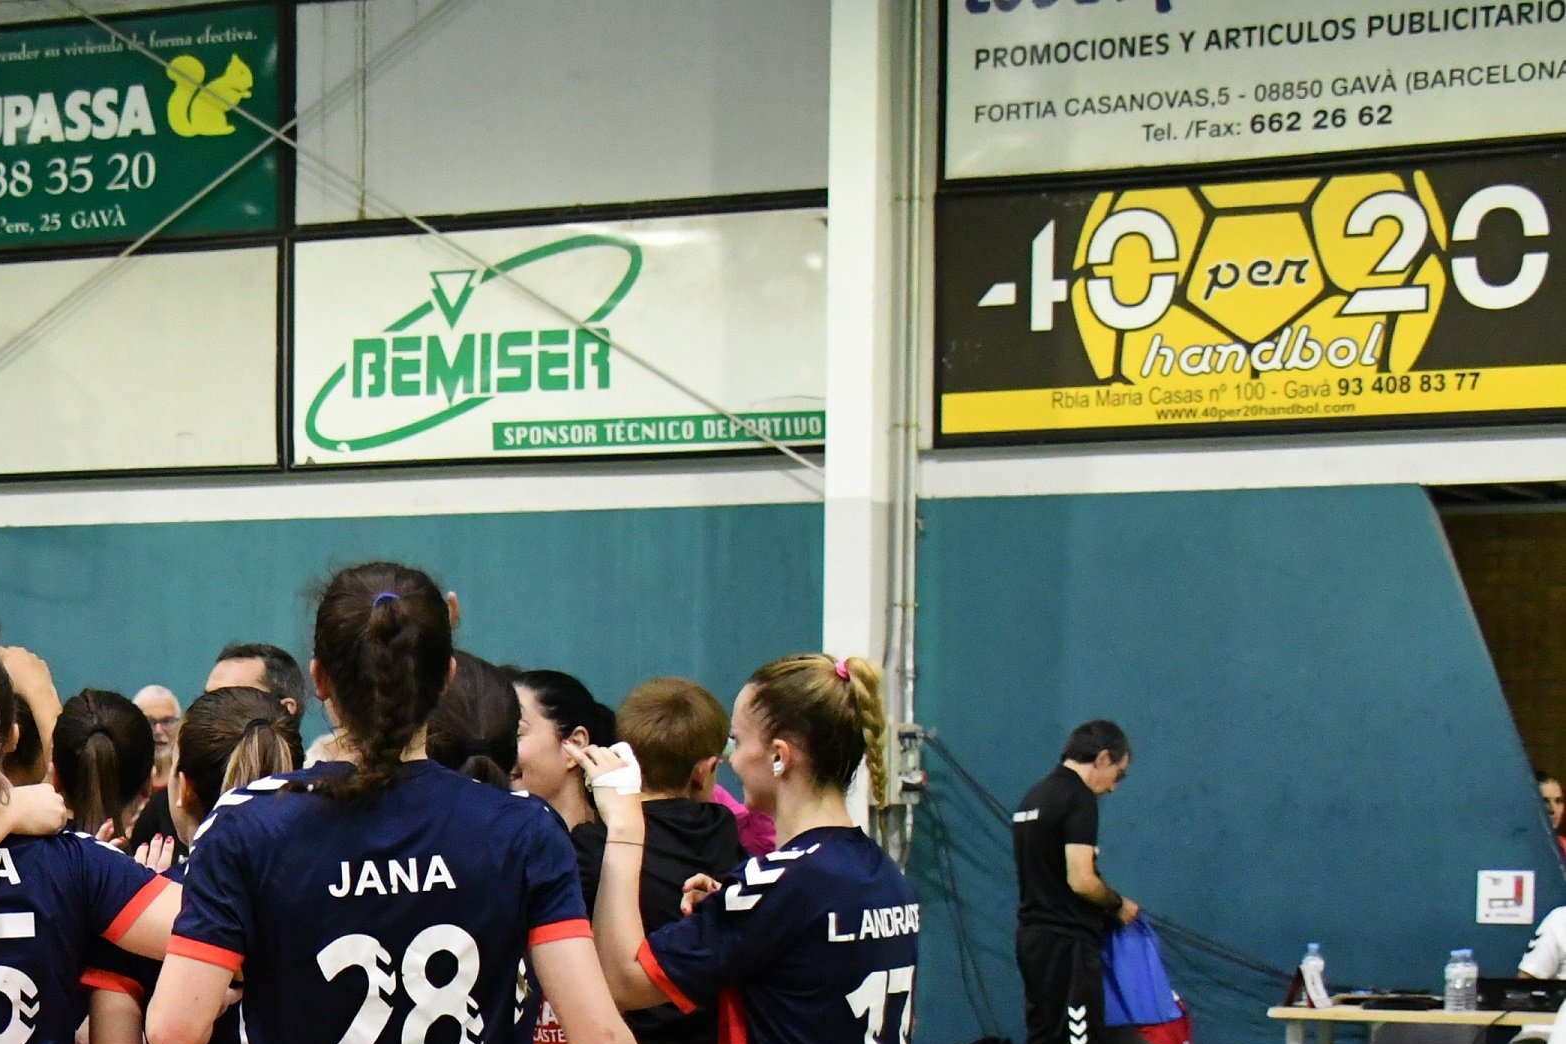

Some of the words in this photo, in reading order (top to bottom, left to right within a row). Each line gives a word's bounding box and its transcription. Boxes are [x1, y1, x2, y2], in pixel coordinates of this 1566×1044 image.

[64, 33, 124, 56] vivienda
[149, 29, 193, 49] forma
[974, 33, 1170, 70] PROMOCIONES
[1179, 31, 1196, 53] Y
[1204, 17, 1356, 51] ARTICULOS
[974, 100, 1057, 124] FORTIA
[1253, 79, 1323, 102] 08850
[1142, 123, 1177, 142] Tel.
[1184, 119, 1242, 140] /Fax:
[1250, 110, 1301, 134] 662
[1312, 107, 1346, 131] 26
[1358, 104, 1393, 126] 62
[44, 154, 94, 195] 35
[105, 151, 156, 192] 20
[40, 213, 61, 232] 25
[71, 204, 127, 229] GAVÀ
[1202, 254, 1311, 303] per
[1336, 184, 1551, 318] 20
[352, 327, 611, 406] BEMISER
[1139, 320, 1385, 380] handbol
[1148, 386, 1203, 405] Casas
[1234, 382, 1266, 401] 100
[1337, 377, 1364, 397] 93
[1371, 375, 1411, 394] 408
[1419, 373, 1446, 392] 83
[1454, 371, 1481, 391] 77
[503, 422, 597, 446] SPONSOR
[604, 418, 696, 442] TÉCNICO
[328, 855, 456, 898] JANA
